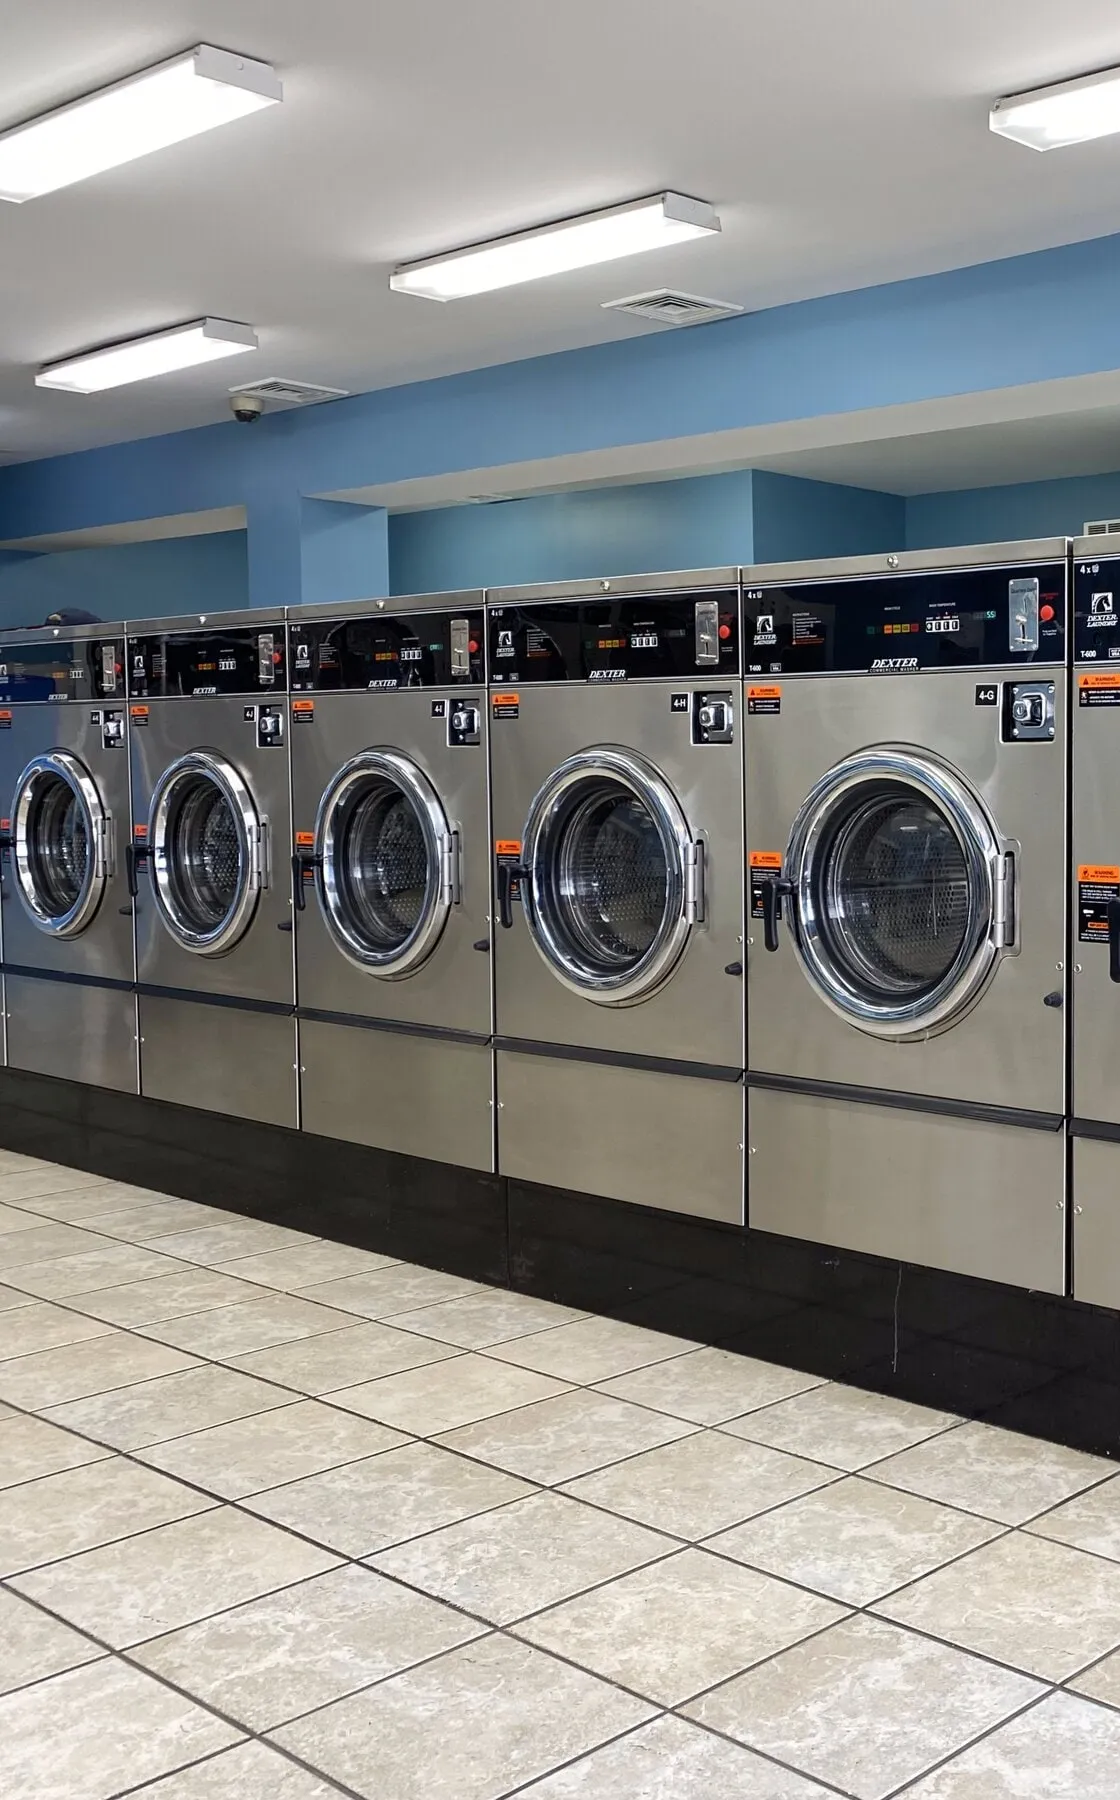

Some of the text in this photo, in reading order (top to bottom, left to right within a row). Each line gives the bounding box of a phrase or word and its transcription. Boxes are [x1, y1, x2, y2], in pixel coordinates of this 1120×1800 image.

[1080, 565, 1085, 574] 4
[871, 658, 917, 668] DEXTER
[589, 670, 625, 678] DEXTER
[979, 691, 995, 700] 4-G
[674, 698, 686, 707] 4-H
